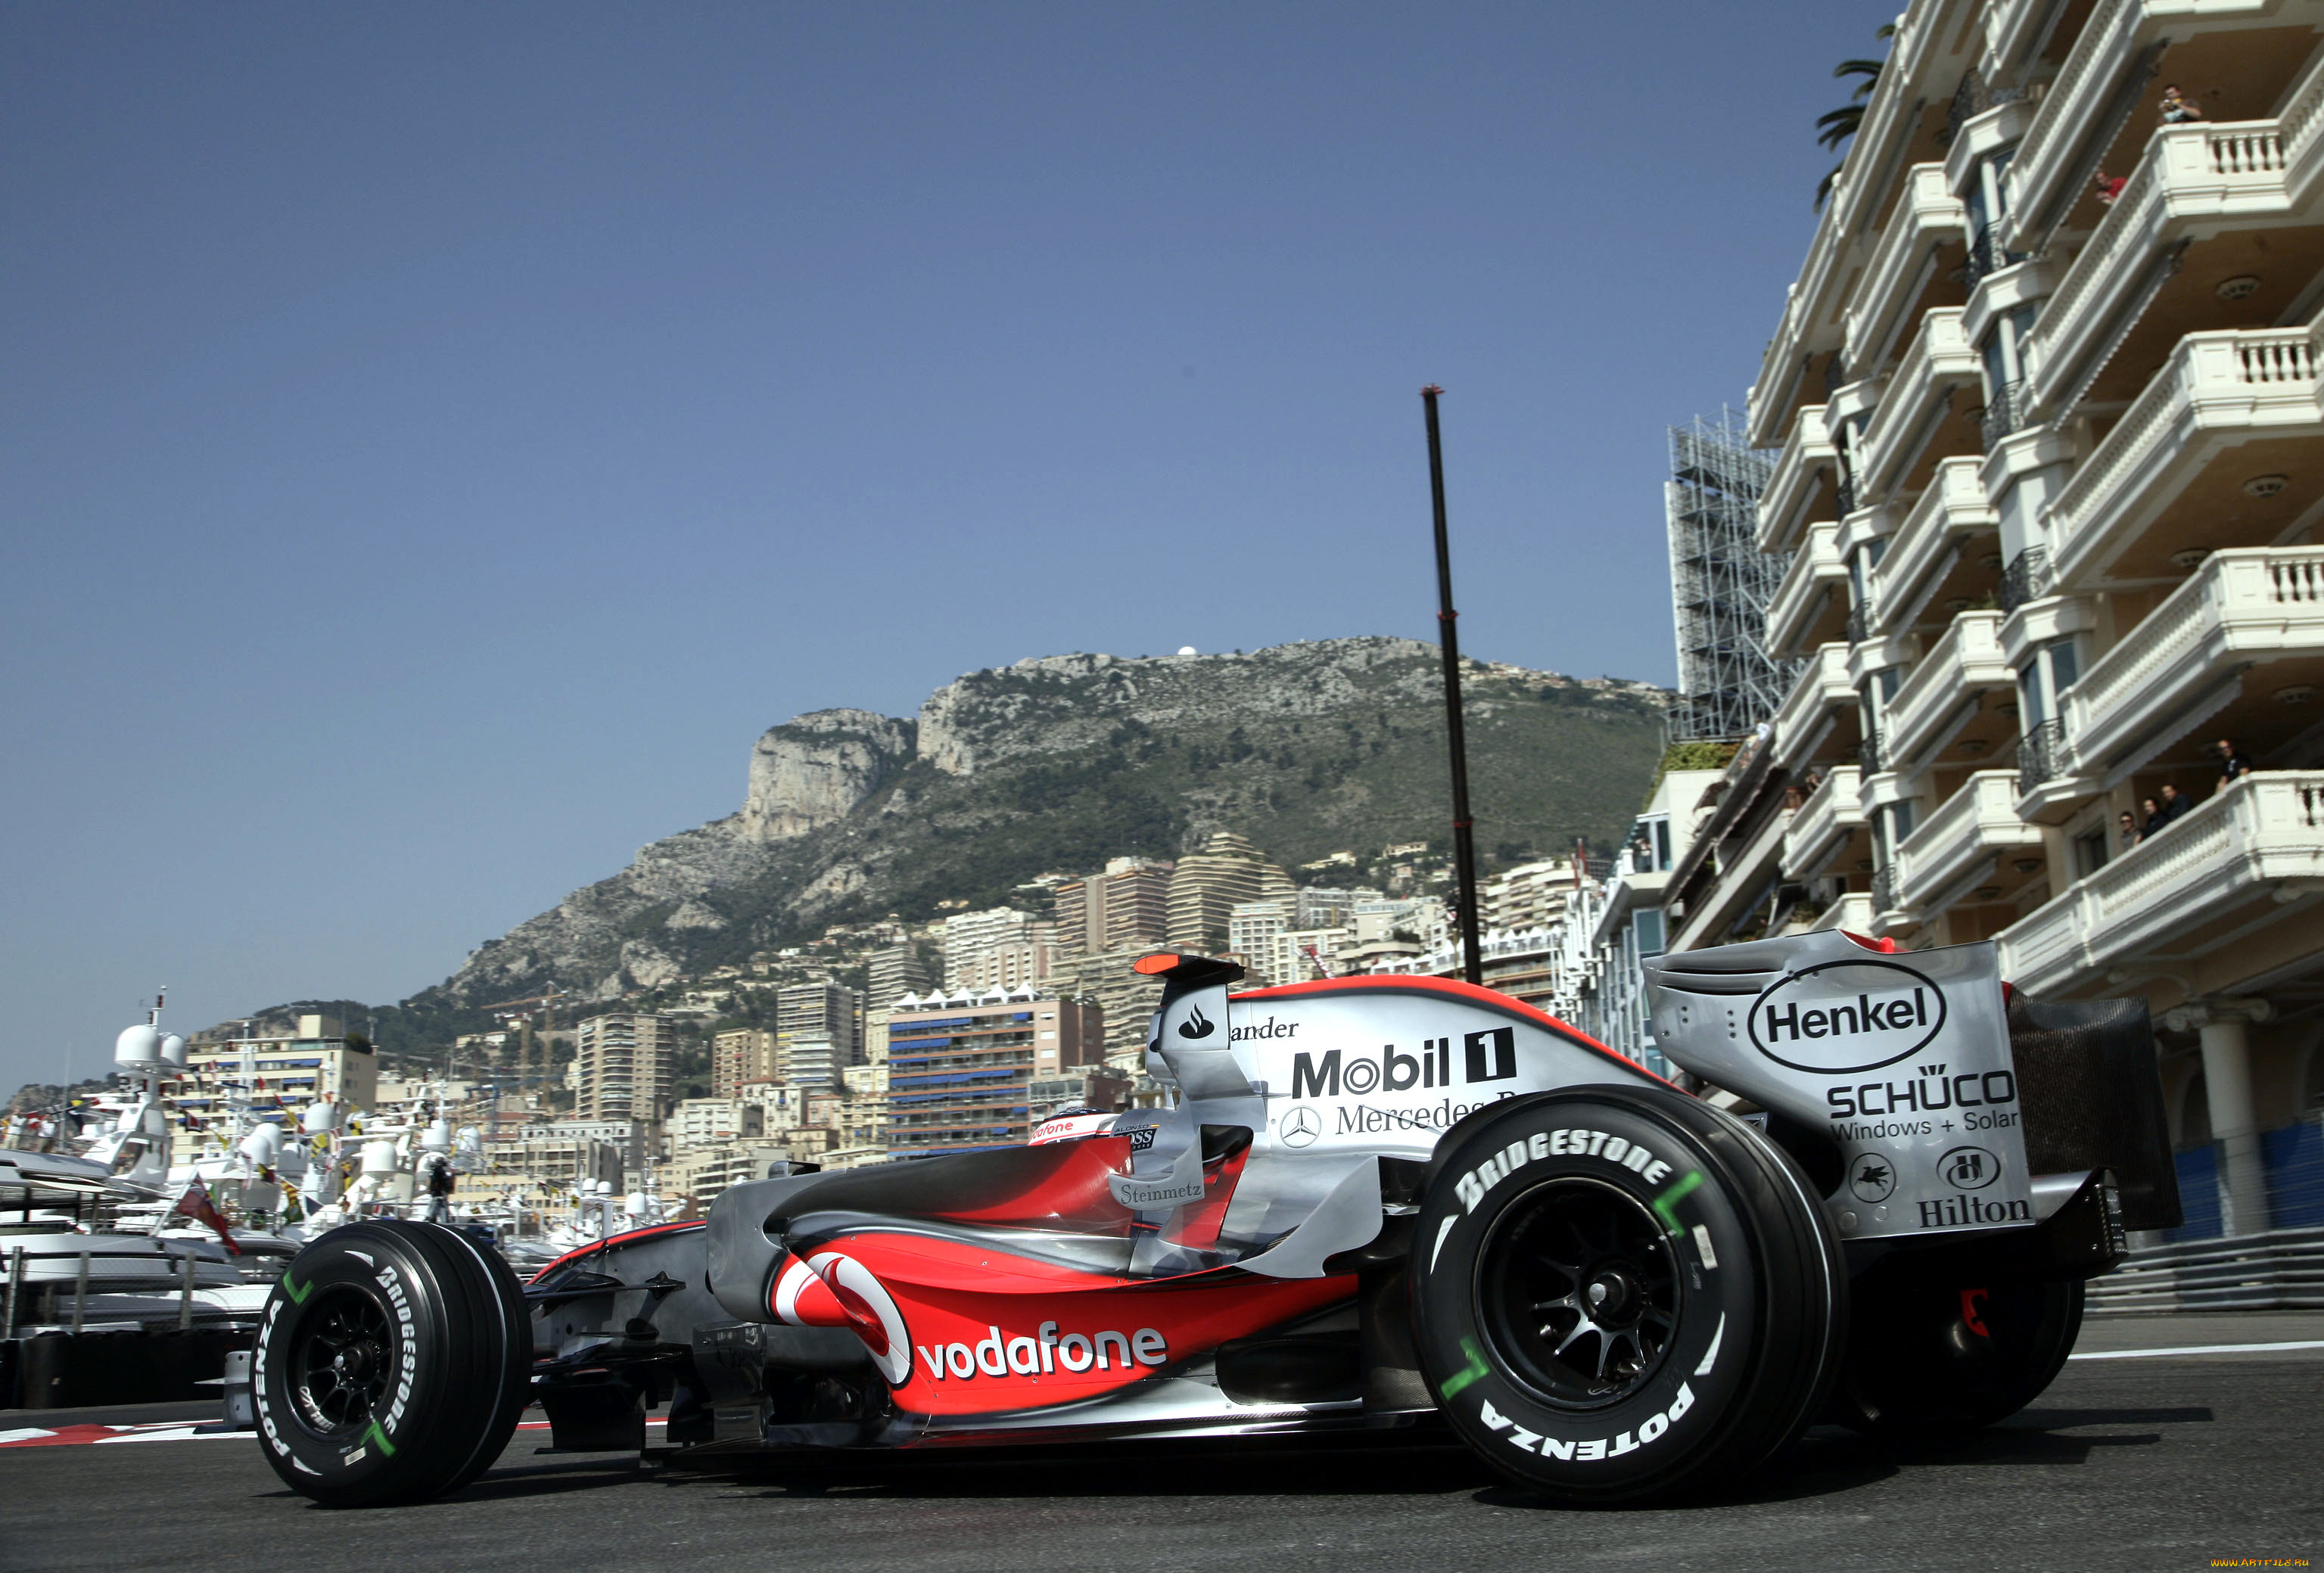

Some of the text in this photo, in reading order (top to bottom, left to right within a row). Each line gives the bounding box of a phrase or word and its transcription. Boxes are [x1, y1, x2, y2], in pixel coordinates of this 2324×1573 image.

[1230, 1016, 1299, 1042] ander
[1766, 987, 1927, 1043] Henkel
[1292, 1037, 1449, 1099] Mobil
[1827, 1064, 2016, 1119] SCHÜCO
[1115, 1124, 1150, 1133] ALONSO
[1128, 1130, 1153, 1145] OSS
[1831, 1119, 1932, 1142] Windows
[1964, 1110, 2018, 1131] Solar
[1121, 1182, 1202, 1205] Steinmetz
[1454, 1129, 1673, 1216] BRIDGESTONE
[1918, 1195, 2033, 1228] Hilton
[375, 1265, 416, 1436] BRIDGESTONE
[916, 1321, 1167, 1379] vodafone
[254, 1299, 291, 1457] POTENZA
[1479, 1380, 1696, 1461] POTENZA
